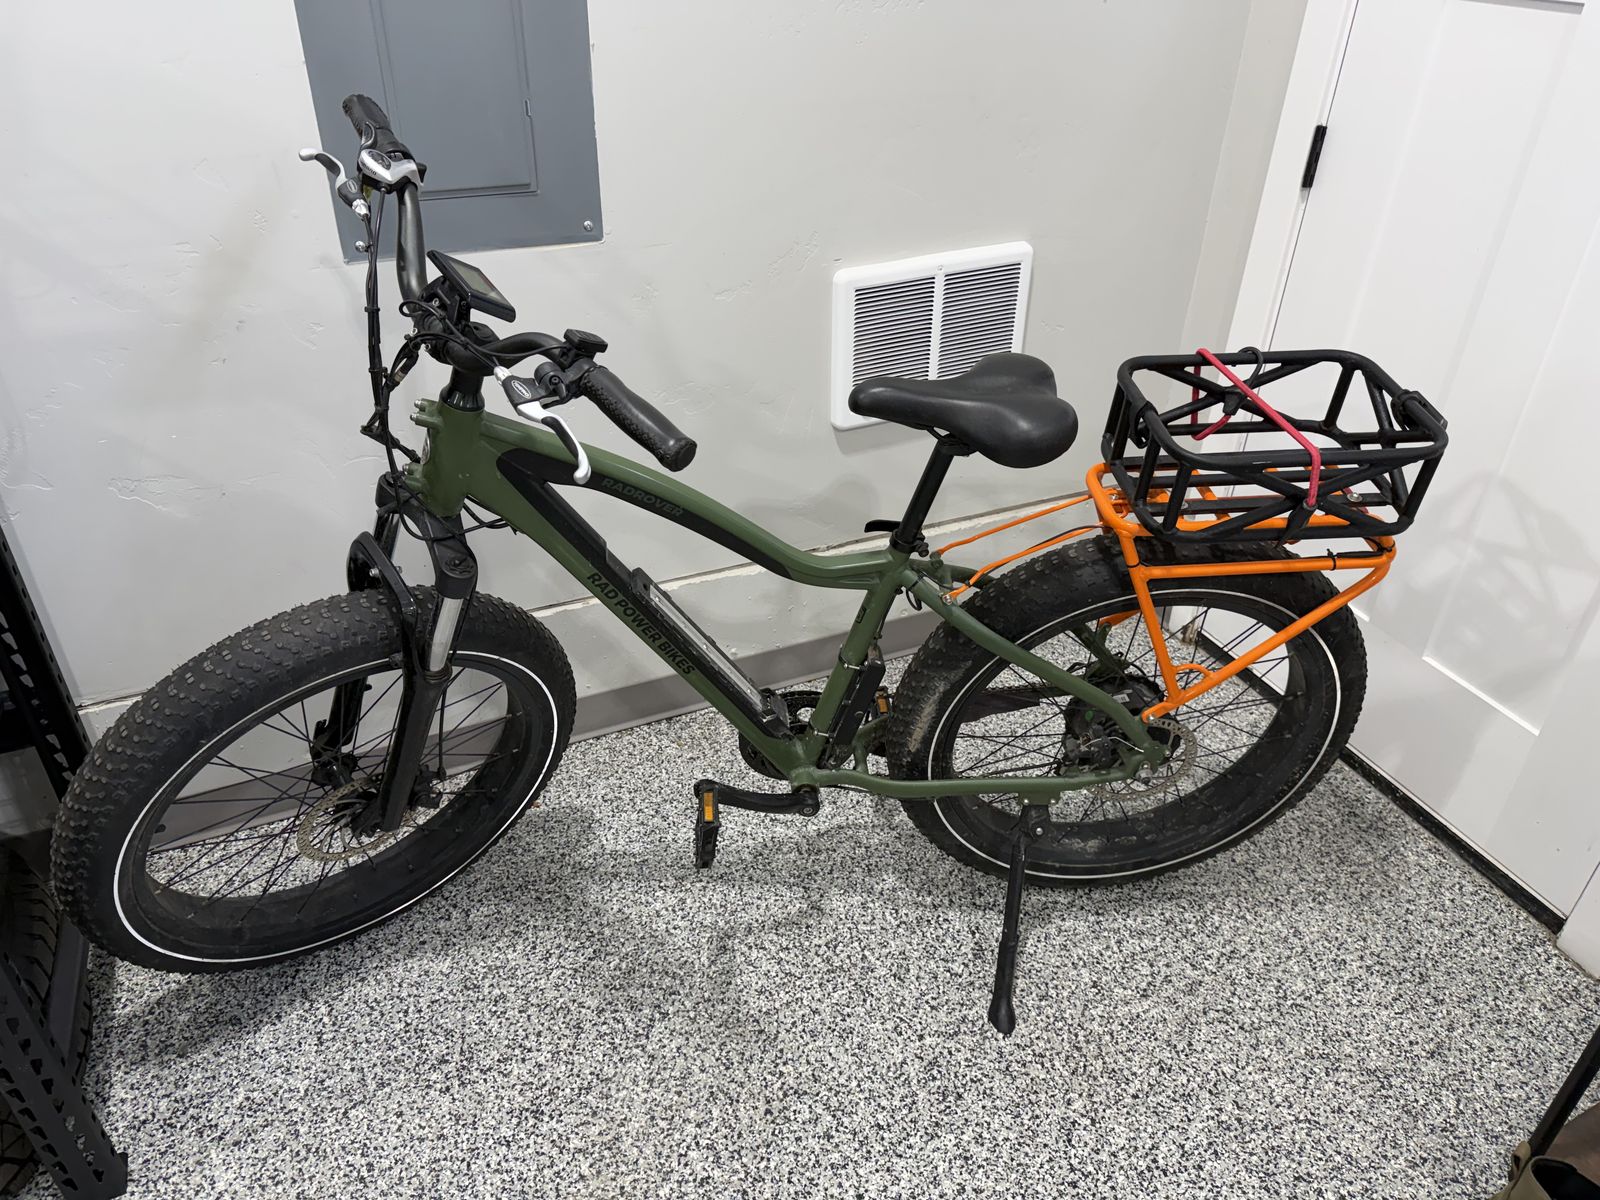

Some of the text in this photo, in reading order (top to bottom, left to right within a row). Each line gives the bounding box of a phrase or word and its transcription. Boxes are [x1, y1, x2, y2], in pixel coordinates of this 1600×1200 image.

[601, 477, 684, 517] RADROVER
[587, 572, 696, 675] RAD POWER BIKES
